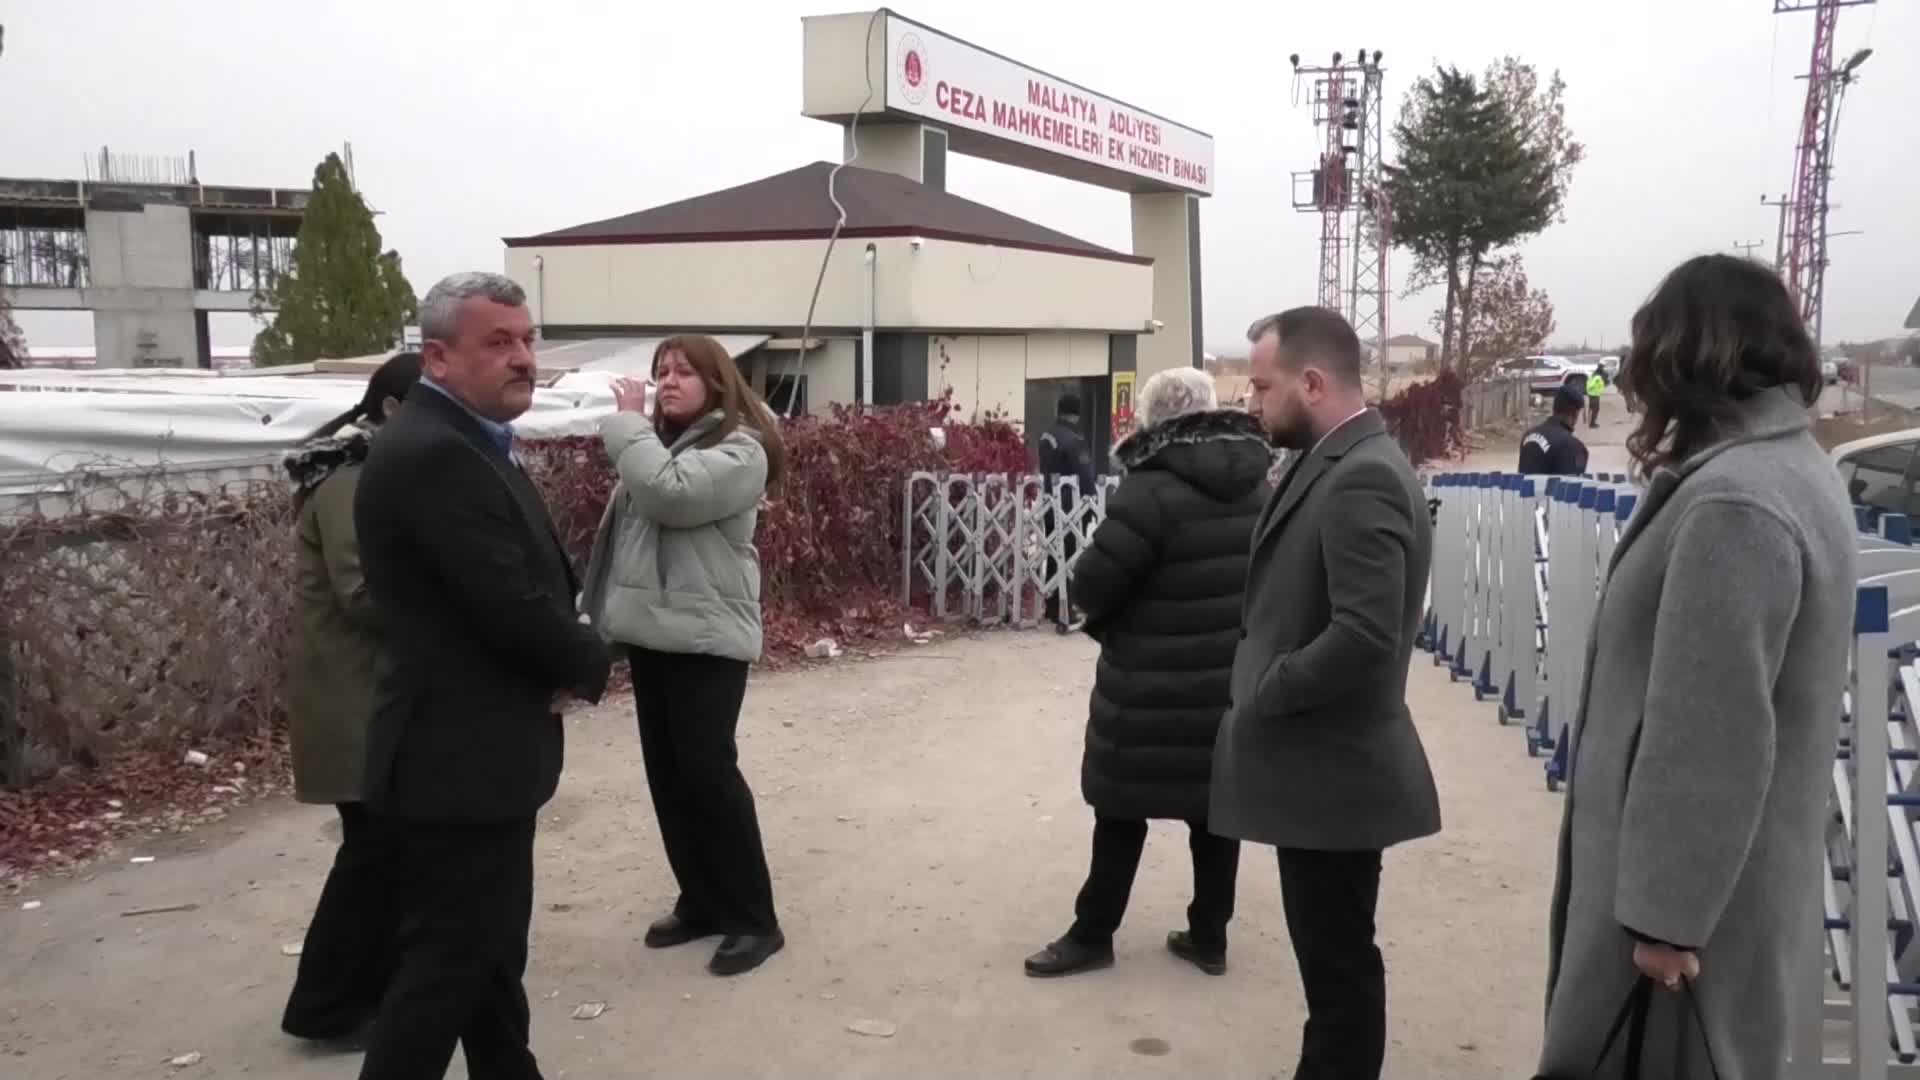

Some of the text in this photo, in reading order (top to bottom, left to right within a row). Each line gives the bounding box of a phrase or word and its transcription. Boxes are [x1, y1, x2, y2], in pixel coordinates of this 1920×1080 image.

[936, 80, 987, 123] CEZA
[1108, 139, 1125, 161] EK
[1027, 79, 1097, 125] MALATYA
